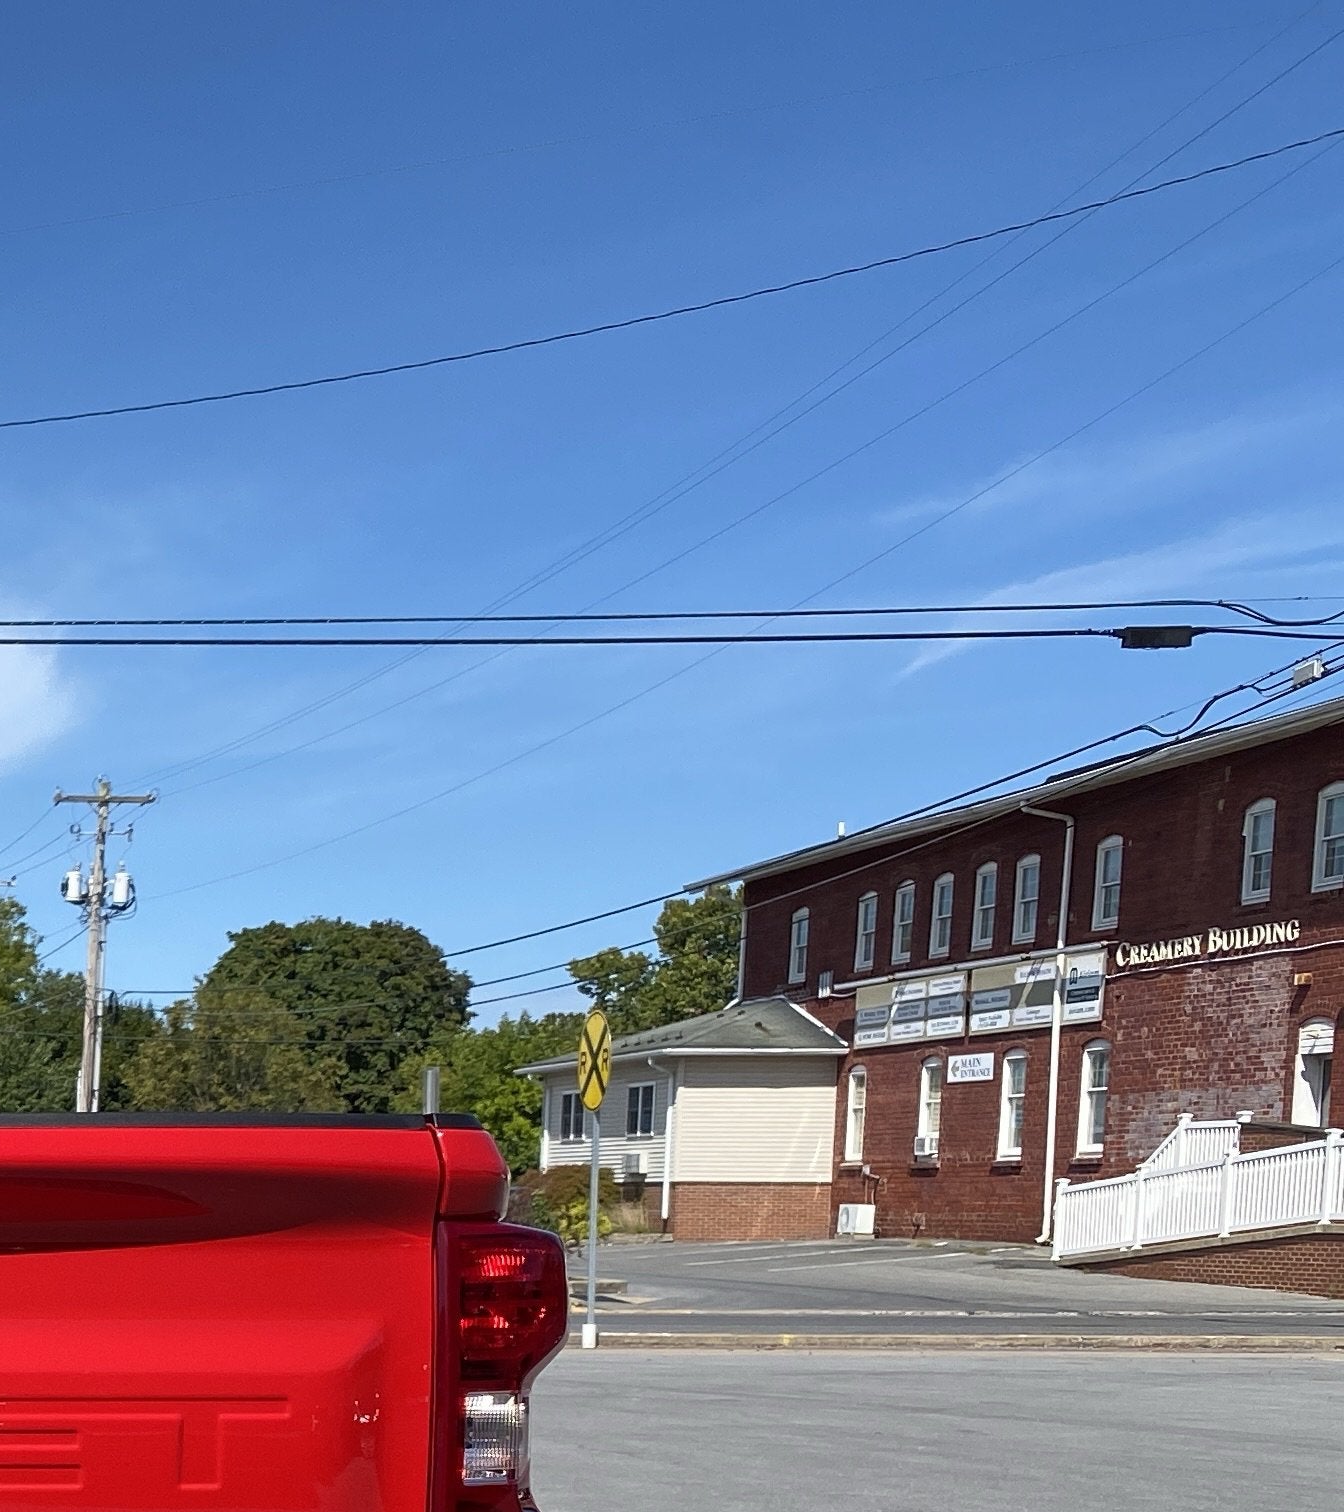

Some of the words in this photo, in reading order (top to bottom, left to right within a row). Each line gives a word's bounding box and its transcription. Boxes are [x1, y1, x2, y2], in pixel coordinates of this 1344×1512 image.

[1115, 934, 1203, 967] CREAMERY
[1207, 919, 1301, 953] BUILDING
[960, 1057, 982, 1068] MAIN
[960, 1067, 991, 1078] ENTRANCE
